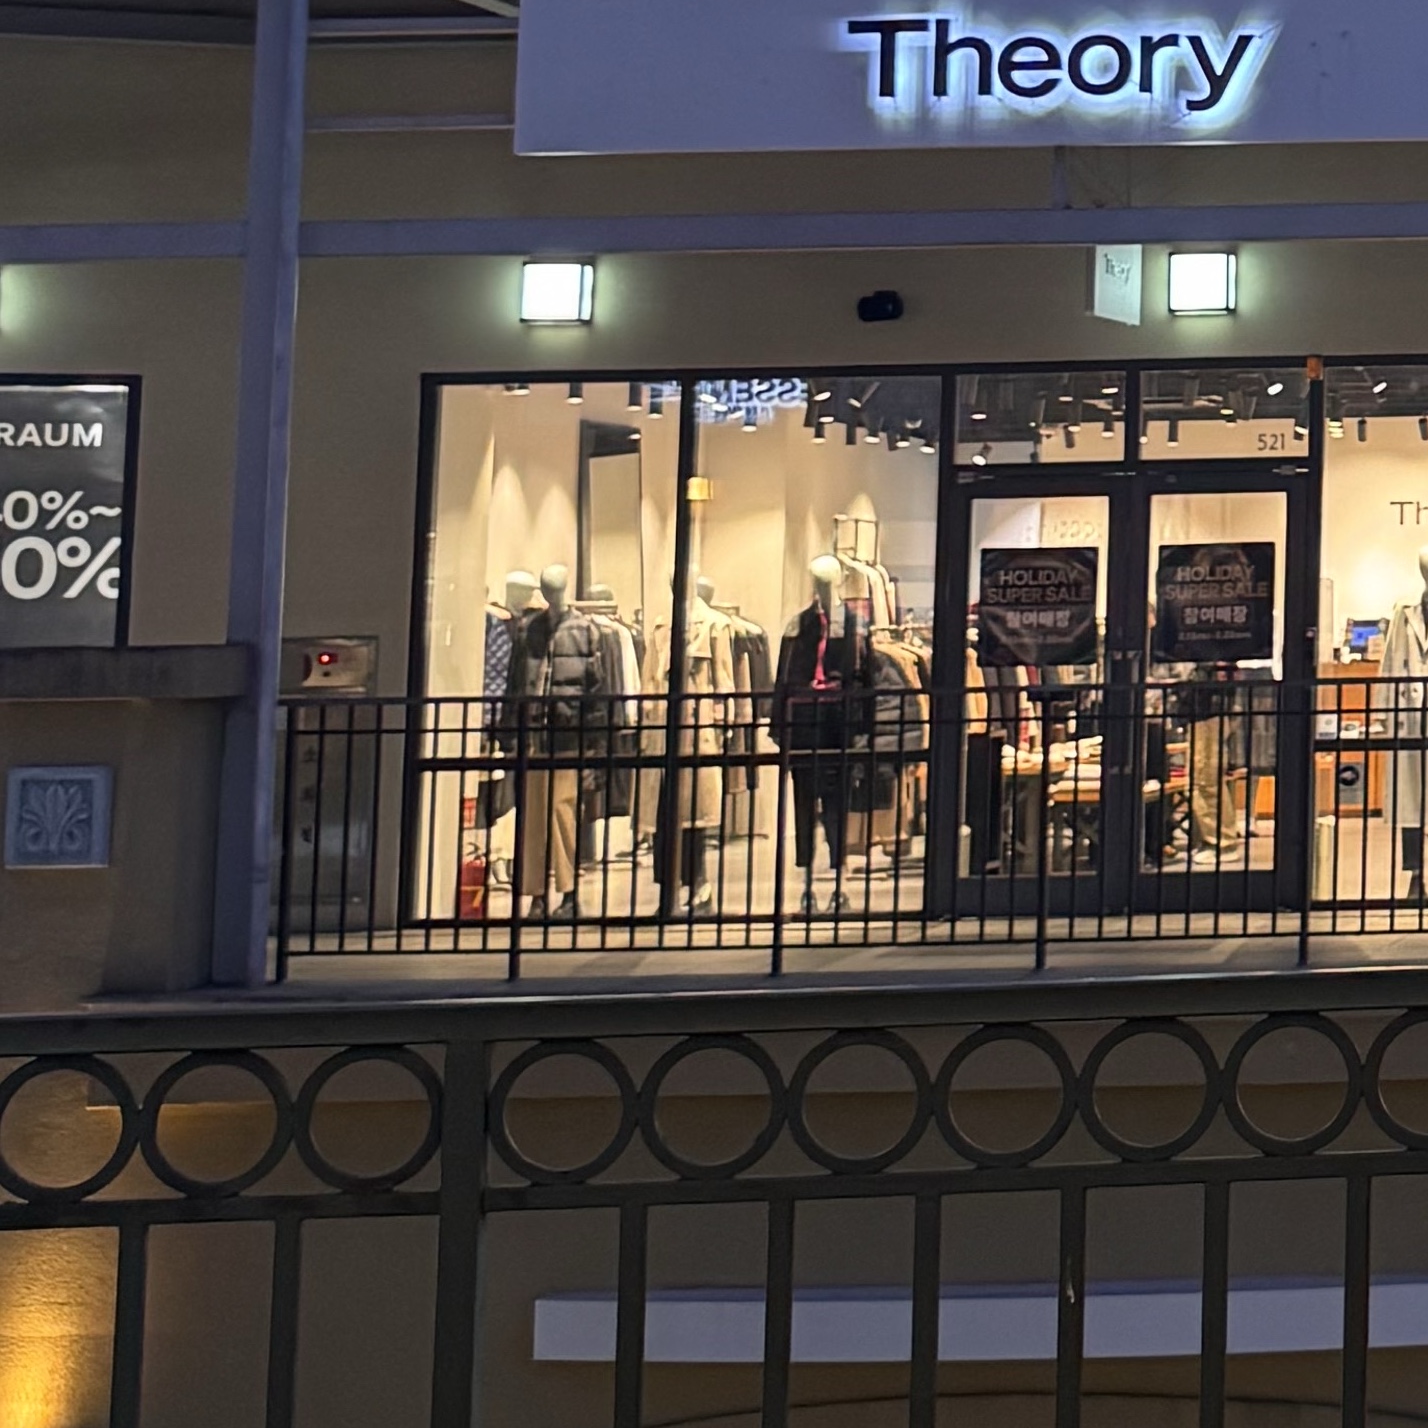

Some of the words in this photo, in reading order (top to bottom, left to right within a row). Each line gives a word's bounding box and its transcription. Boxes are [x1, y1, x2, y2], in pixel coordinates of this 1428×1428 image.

[848, 18, 1256, 112] Theory
[1257, 433, 1285, 451] 521
[0, 490, 122, 530] 0%~
[999, 569, 1078, 586] HOLIDAY
[1176, 565, 1254, 582] HOLIDAY
[987, 587, 1043, 604] SUPER
[1045, 585, 1092, 603] SALE
[1165, 583, 1220, 601] SUPER
[1222, 581, 1268, 598] SALE
[1184, 605, 1248, 625] 참여매장
